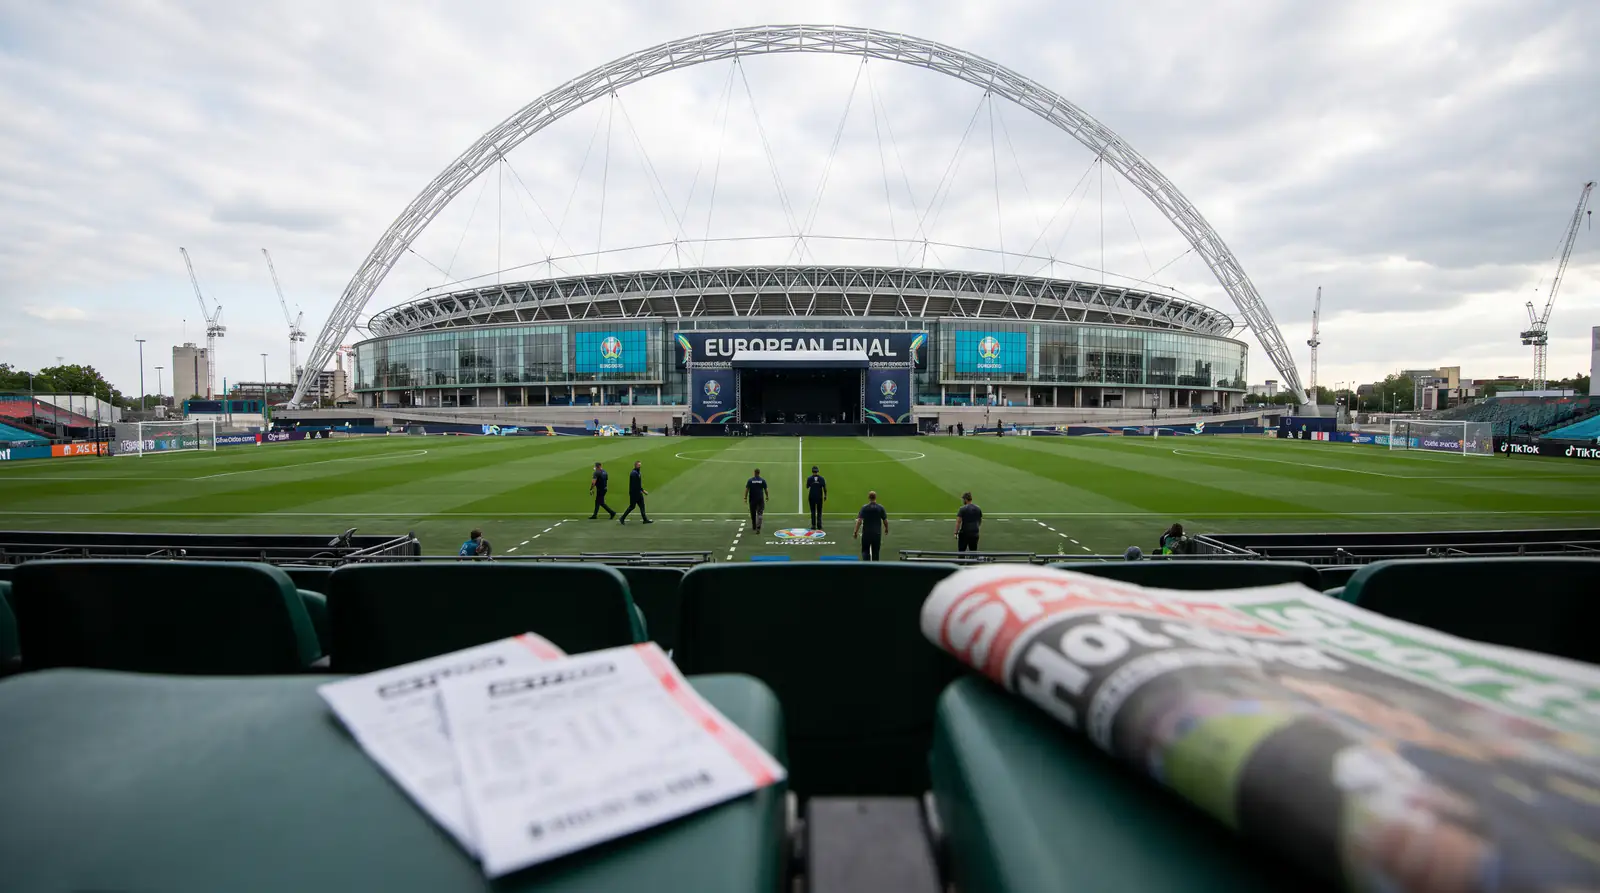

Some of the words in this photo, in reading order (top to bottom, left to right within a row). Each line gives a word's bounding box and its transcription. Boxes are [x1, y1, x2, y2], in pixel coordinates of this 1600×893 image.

[704, 338, 828, 357] EUROPEAN
[1510, 443, 1540, 454] TikTok
[1019, 612, 1171, 730] Hot
